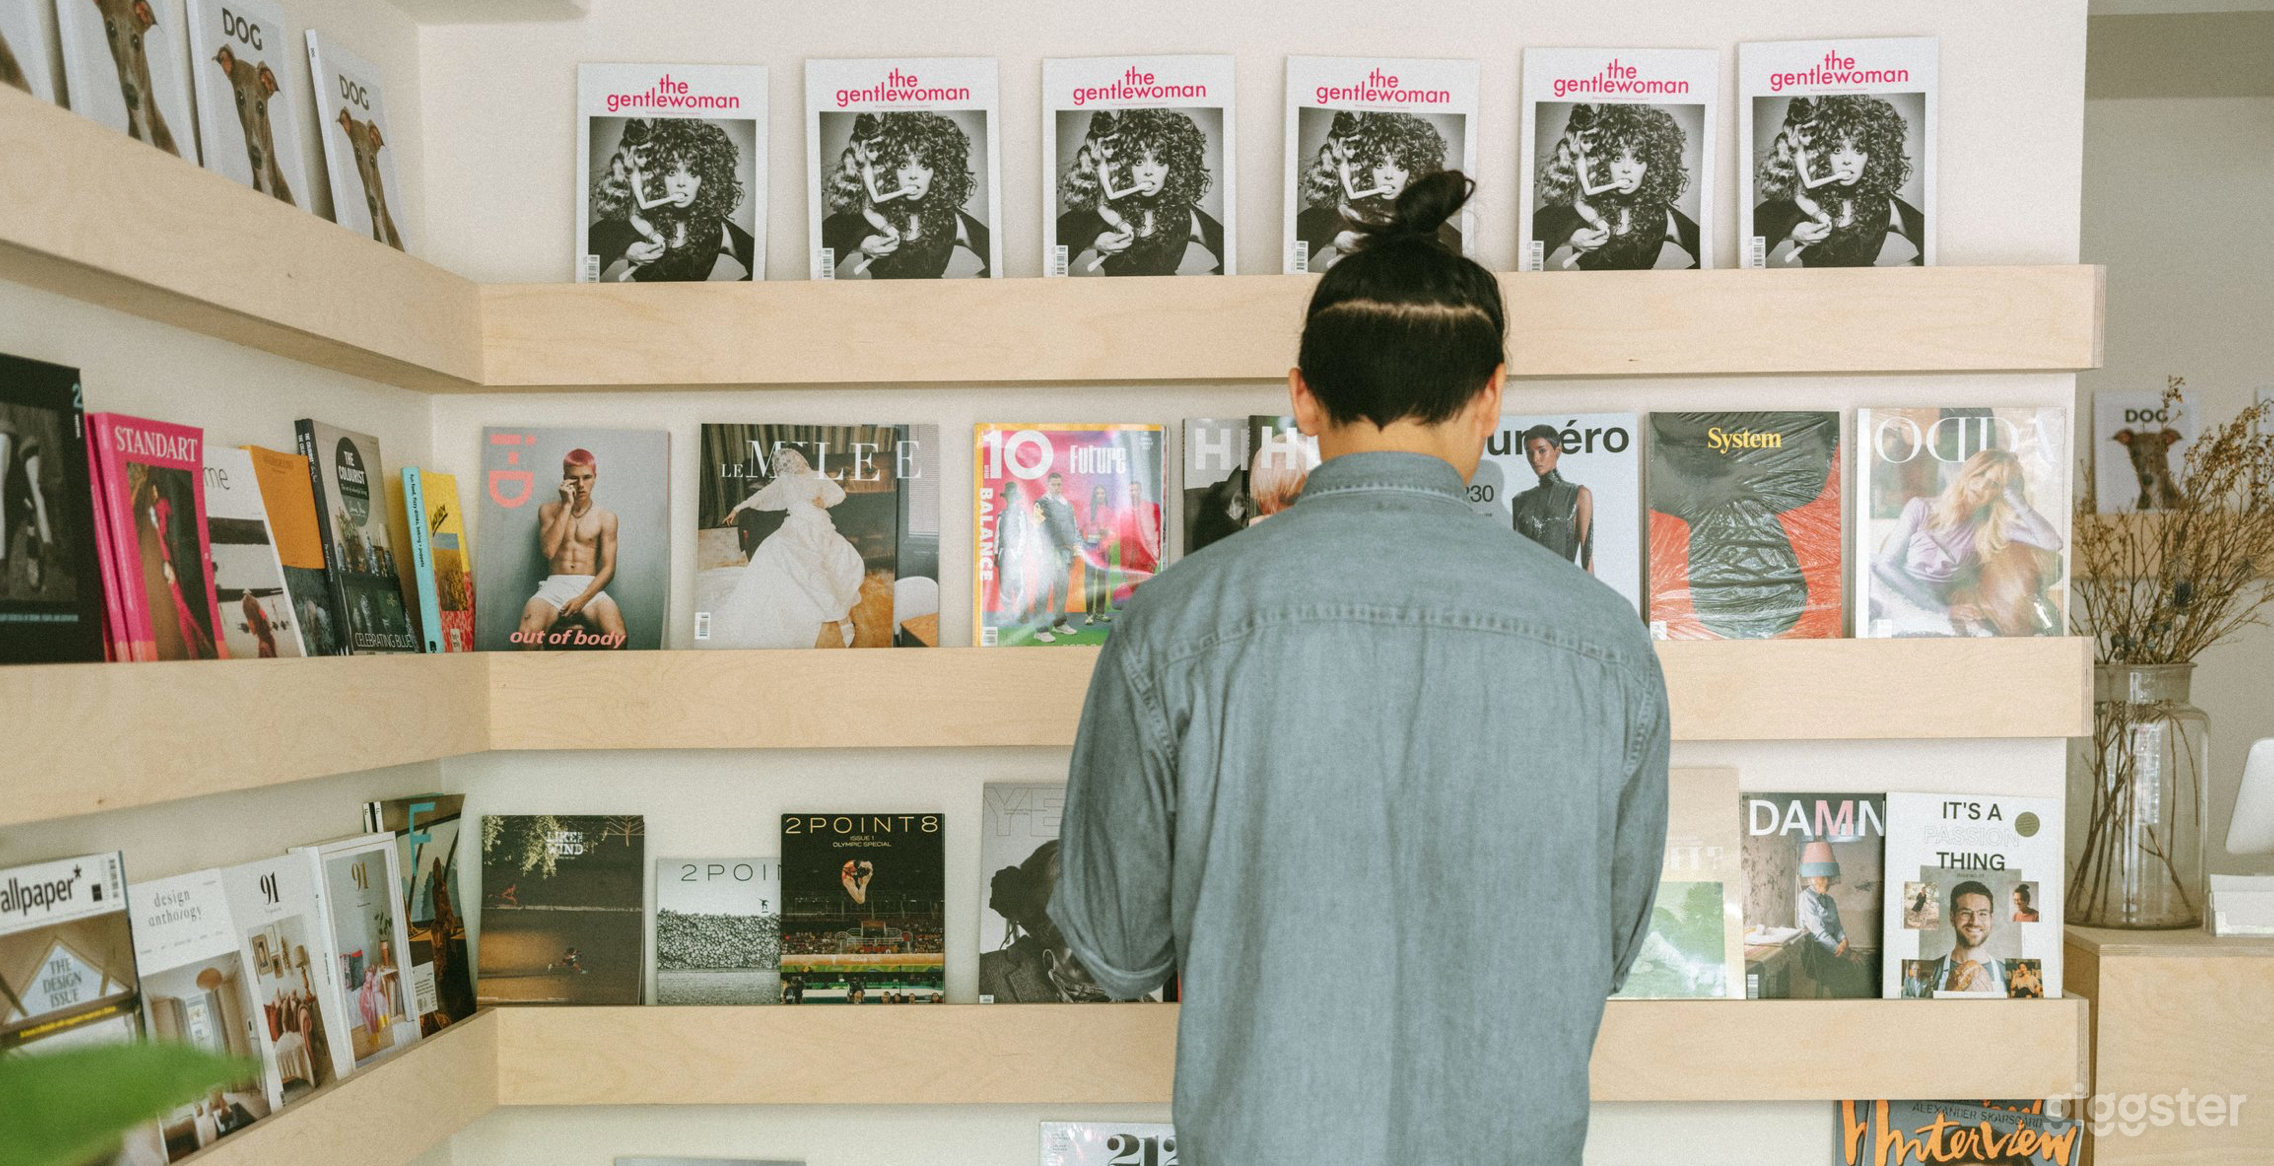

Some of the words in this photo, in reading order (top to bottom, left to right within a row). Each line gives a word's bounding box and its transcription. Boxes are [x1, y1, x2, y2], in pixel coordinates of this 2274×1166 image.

[222, 7, 262, 51] DOG
[1607, 58, 1638, 79] the
[1824, 50, 1856, 71] the
[659, 74, 689, 94] the
[889, 68, 918, 88] the
[1125, 66, 1155, 86] the
[1369, 68, 1399, 89] the
[1554, 73, 1689, 98] gentlewoman
[1771, 64, 1910, 93] gentlewoman
[339, 74, 370, 110] DOG
[607, 88, 740, 112] gentlewoman
[836, 81, 970, 108] gentlewoman
[1073, 79, 1207, 106] gentlewoman
[1316, 82, 1451, 105] gentlewoman
[2125, 409, 2168, 423] DOG
[115, 425, 198, 462] STANDART
[1707, 427, 1782, 454] System
[344, 450, 355, 467] THE
[983, 430, 1054, 480] 10
[1069, 444, 1127, 475] Future
[339, 465, 365, 484] COLOURIST
[721, 463, 743, 477] LE
[1467, 484, 1495, 503] 30
[979, 487, 994, 582] BALANCE
[355, 632, 395, 648] CELEBRATING
[395, 634, 414, 648] BLUE
[509, 630, 546, 646] out
[549, 629, 572, 646] of
[574, 630, 626, 649] body
[1748, 799, 1885, 837] DAMN
[1943, 801, 1981, 820] IT'S
[1987, 803, 2002, 821] A
[785, 815, 939, 834] 2POINT8
[408, 801, 436, 877] F
[547, 831, 577, 843] LIKE
[1923, 825, 2019, 847] PASSION
[546, 843, 584, 855] WIND
[1936, 851, 2005, 871] THING
[351, 861, 369, 892] 91
[681, 863, 781, 882] 2POI
[260, 871, 280, 905] 91
[154, 890, 191, 908] design
[149, 905, 202, 927] anthology
[50, 957, 72, 975] THE
[43, 971, 82, 994] DESIGN
[51, 988, 80, 1008] ISSUE
[1912, 1103, 1977, 1120] ALEXANDER
